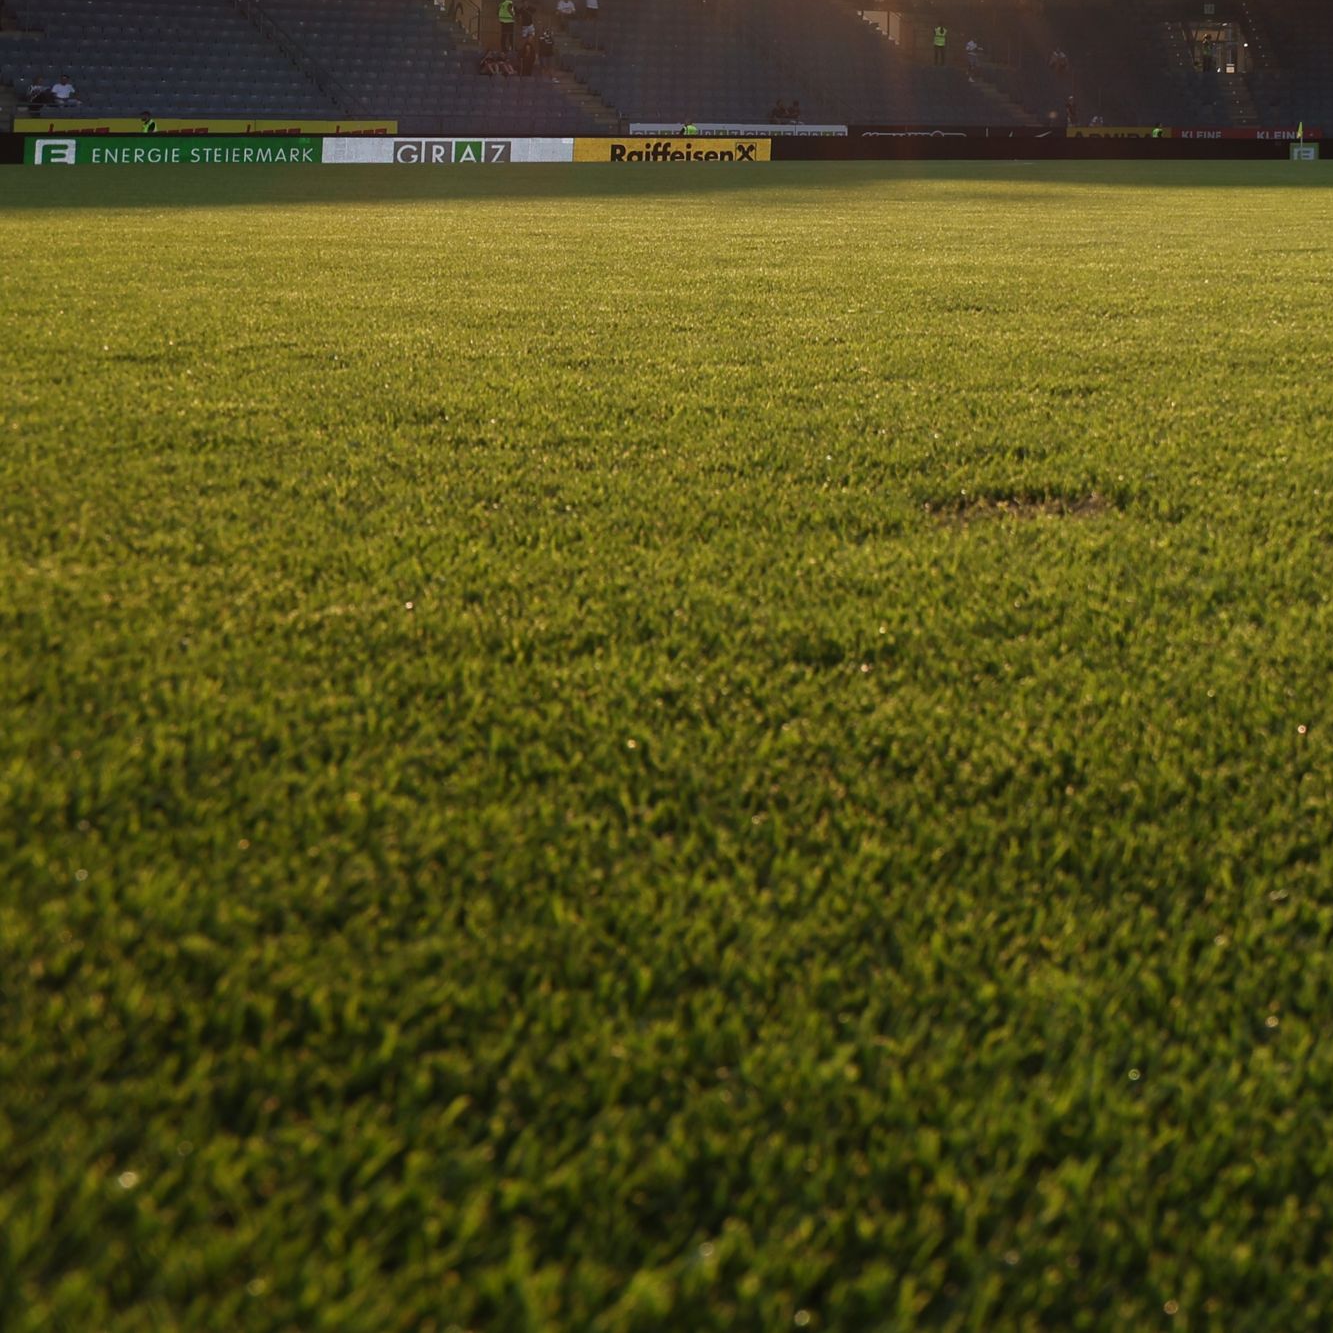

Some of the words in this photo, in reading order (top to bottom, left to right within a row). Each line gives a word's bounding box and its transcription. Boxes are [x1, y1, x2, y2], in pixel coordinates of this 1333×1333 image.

[1256, 130, 1302, 140] KLEIN
[92, 148, 180, 163] ENERGIE
[190, 148, 314, 163] STEIERMARK
[397, 144, 506, 164] GRAZ
[610, 142, 734, 162] Raiffeisen
